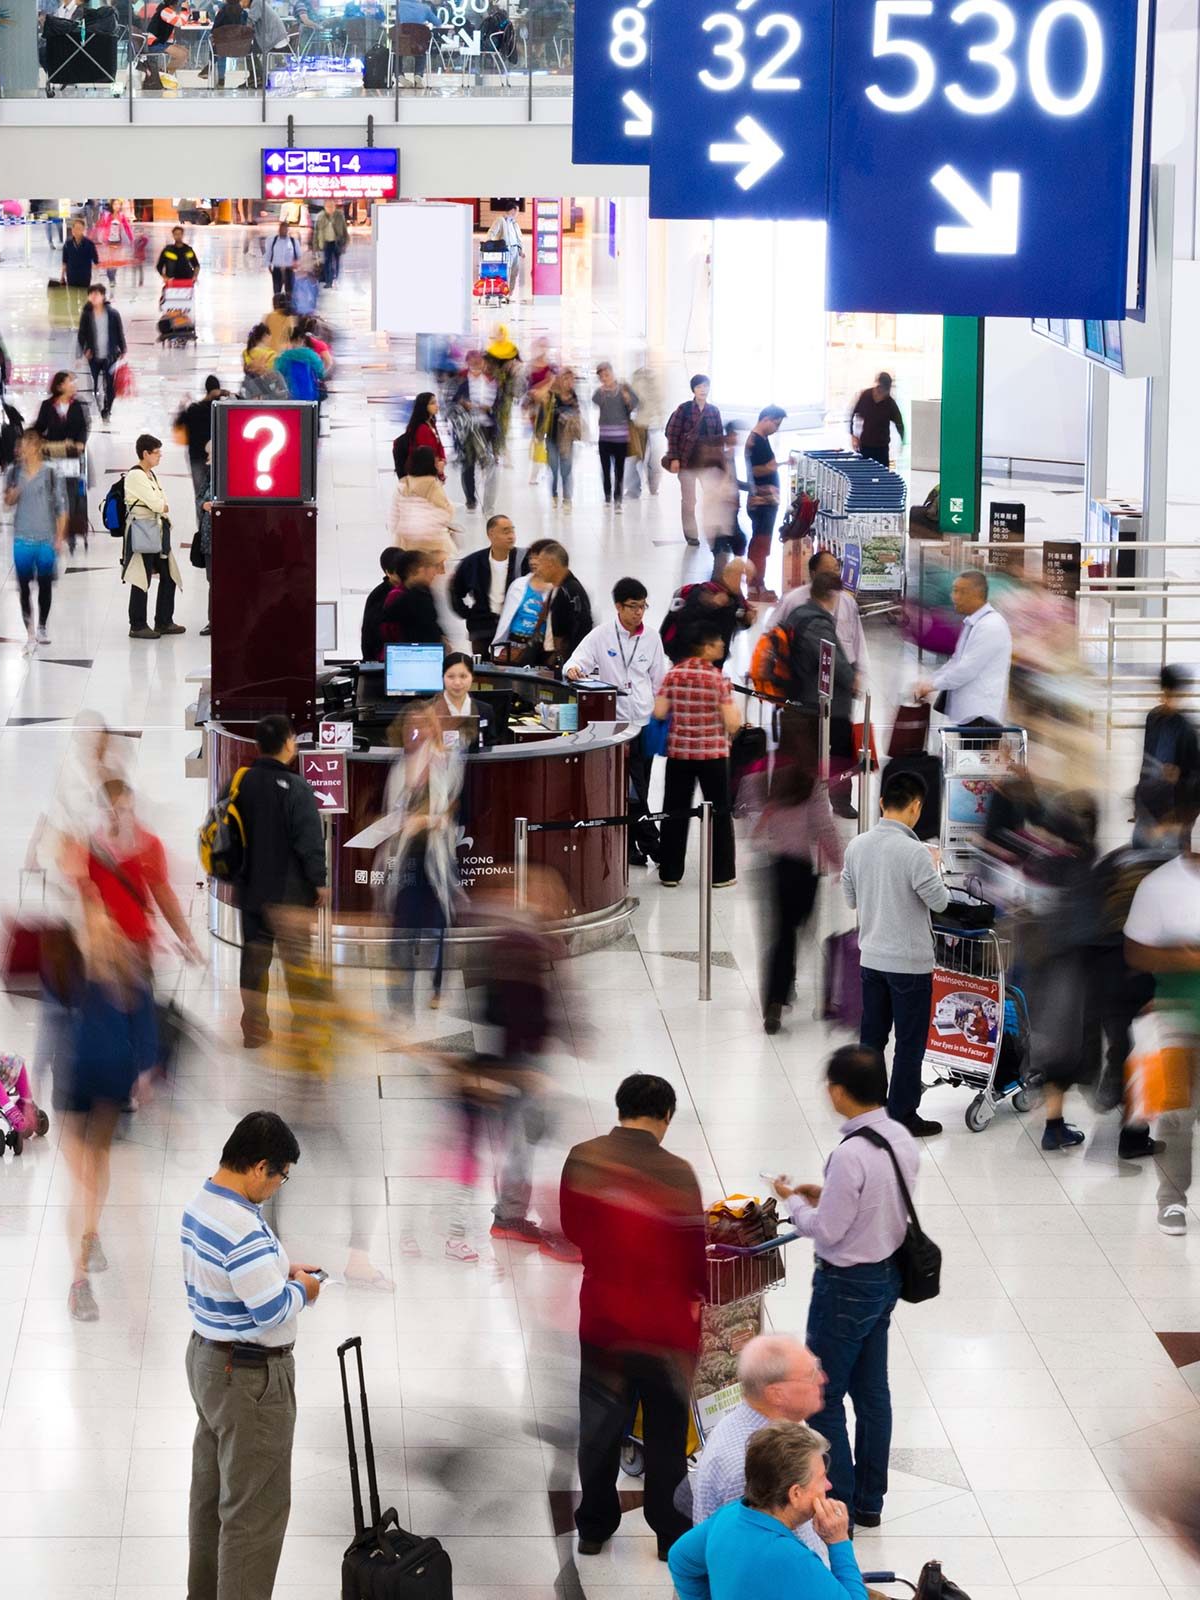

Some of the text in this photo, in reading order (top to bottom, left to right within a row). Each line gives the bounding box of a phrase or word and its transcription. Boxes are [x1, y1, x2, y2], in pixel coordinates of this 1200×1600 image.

[610, 8, 646, 67] 8
[698, 13, 802, 91] 32
[864, 0, 1103, 116] 530
[306, 760, 339, 773] 入口
[307, 779, 342, 787] Entrance
[462, 856, 494, 865] KONG
[461, 867, 515, 876] NATIONAL
[930, 1039, 942, 1048] Your
[942, 1041, 953, 1050] Eyes
[960, 1045, 968, 1053] the
